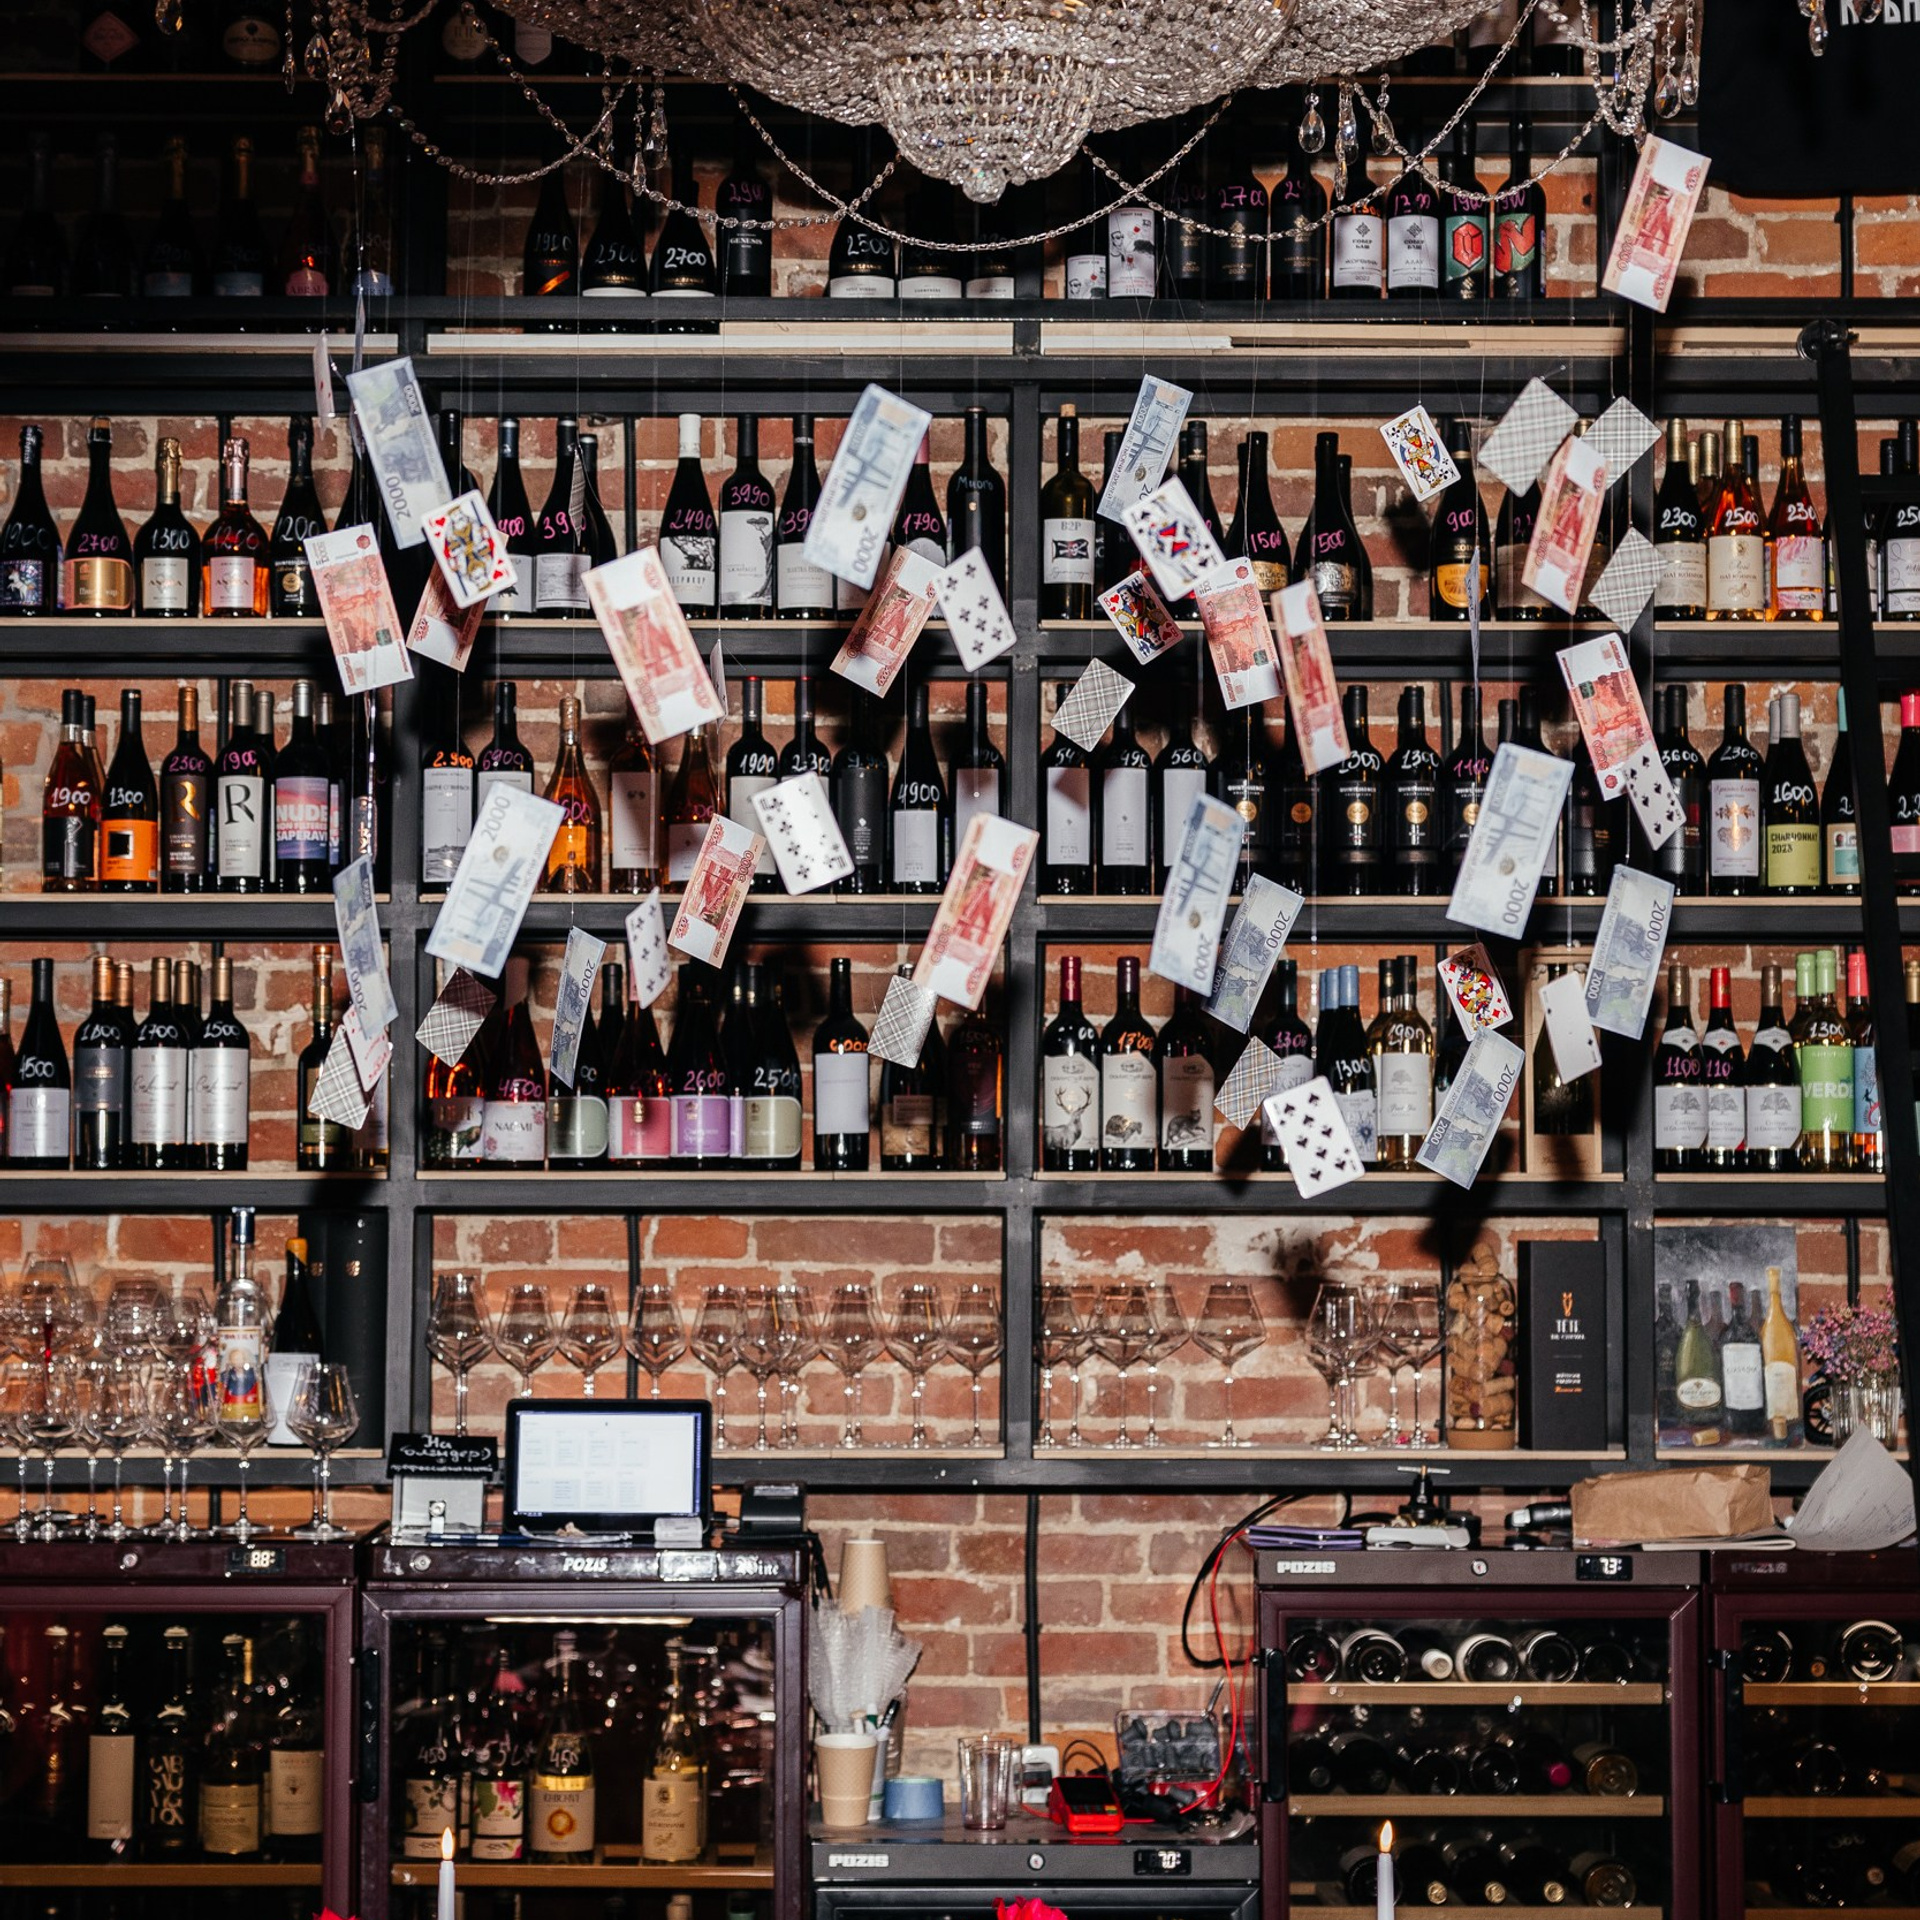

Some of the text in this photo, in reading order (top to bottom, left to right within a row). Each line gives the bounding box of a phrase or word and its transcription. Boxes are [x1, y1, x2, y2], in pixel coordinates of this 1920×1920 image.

[1217, 184, 1267, 209] 2700
[846, 233, 891, 257] 2500
[665, 246, 707, 270] 2700
[384, 475, 411, 521] 2000
[730, 483, 771, 508] 3990
[669, 507, 714, 533] 2490
[902, 513, 940, 535] 1790
[1060, 520, 1082, 532] B2P
[1660, 506, 1698, 529] 2300
[1724, 506, 1760, 528] 2500
[78, 533, 120, 552] 2700
[151, 527, 191, 549] 1300
[1250, 530, 1282, 554] 1500
[1310, 529, 1346, 558] 1500
[168, 755, 206, 773] 2300
[739, 752, 776, 775] 1900
[1720, 745, 1758, 762] 2300
[51, 786, 92, 808] 1900
[109, 787, 145, 808] 1300
[897, 781, 941, 804] 4900
[1772, 781, 1814, 804] 1600
[224, 784, 256, 826] R
[276, 804, 328, 822] NUDE
[481, 796, 511, 843] 2000
[276, 830, 328, 842] SAPERAVI
[1770, 831, 1818, 842] CHARDONNAY
[1771, 844, 1794, 855] 2023
[736, 849, 756, 884] 5000
[1503, 877, 1531, 925] 2000
[1265, 909, 1291, 950] 2000
[1646, 900, 1667, 942] 2000
[1193, 934, 1214, 981] 2000
[349, 969, 368, 1012] 2000
[579, 958, 597, 1000] 2000
[1211, 967, 1225, 993] 2000
[1587, 972, 1604, 1000] 2000
[138, 1023, 179, 1042] 1700
[203, 1022, 241, 1039] 1500
[1810, 1021, 1846, 1039] 1300
[754, 1066, 800, 1088] 2500
[1335, 1058, 1371, 1080] 1300
[1665, 1056, 1700, 1078] 1100
[683, 1069, 726, 1092] 2600
[1493, 1063, 1517, 1103] 2000
[1429, 1119, 1449, 1146] 2000
[420, 1433, 453, 1450] На
[562, 1556, 610, 1573] POZIS
[736, 1555, 780, 1576] Wine
[1276, 1560, 1337, 1574] POZIS
[1731, 1560, 1788, 1575] POZIS
[828, 1852, 890, 1868] POZIS
